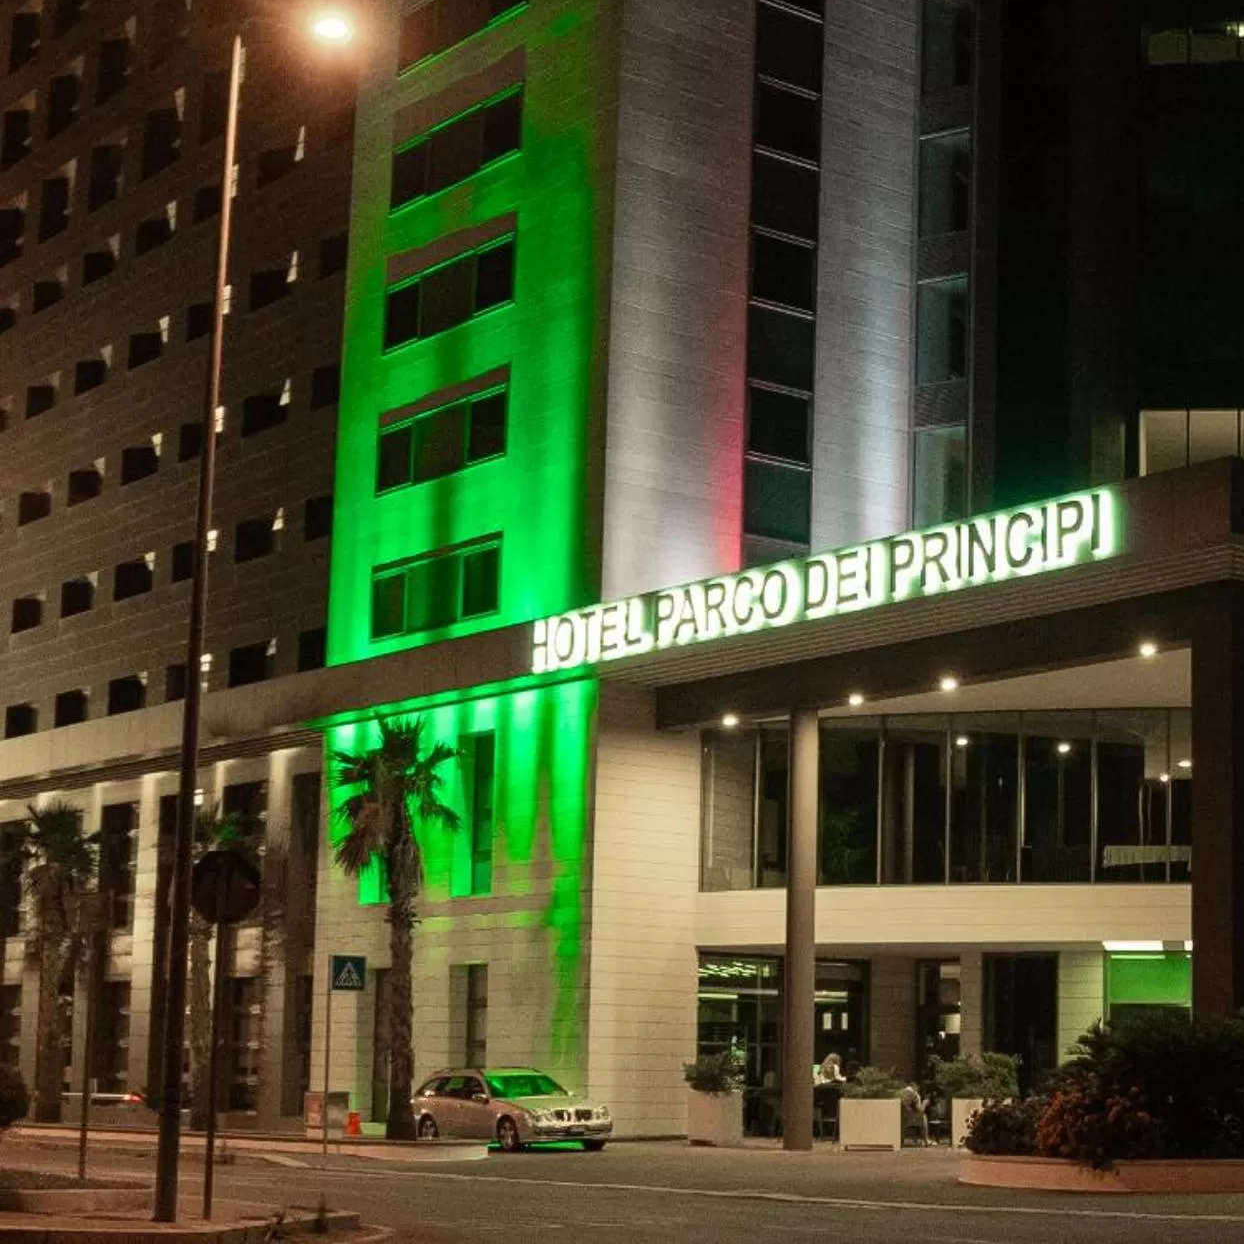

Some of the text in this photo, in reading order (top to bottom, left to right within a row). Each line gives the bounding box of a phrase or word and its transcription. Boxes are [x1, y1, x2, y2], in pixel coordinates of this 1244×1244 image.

[530, 494, 1101, 671] HOTEL PARCO DEI PRINCIPI
